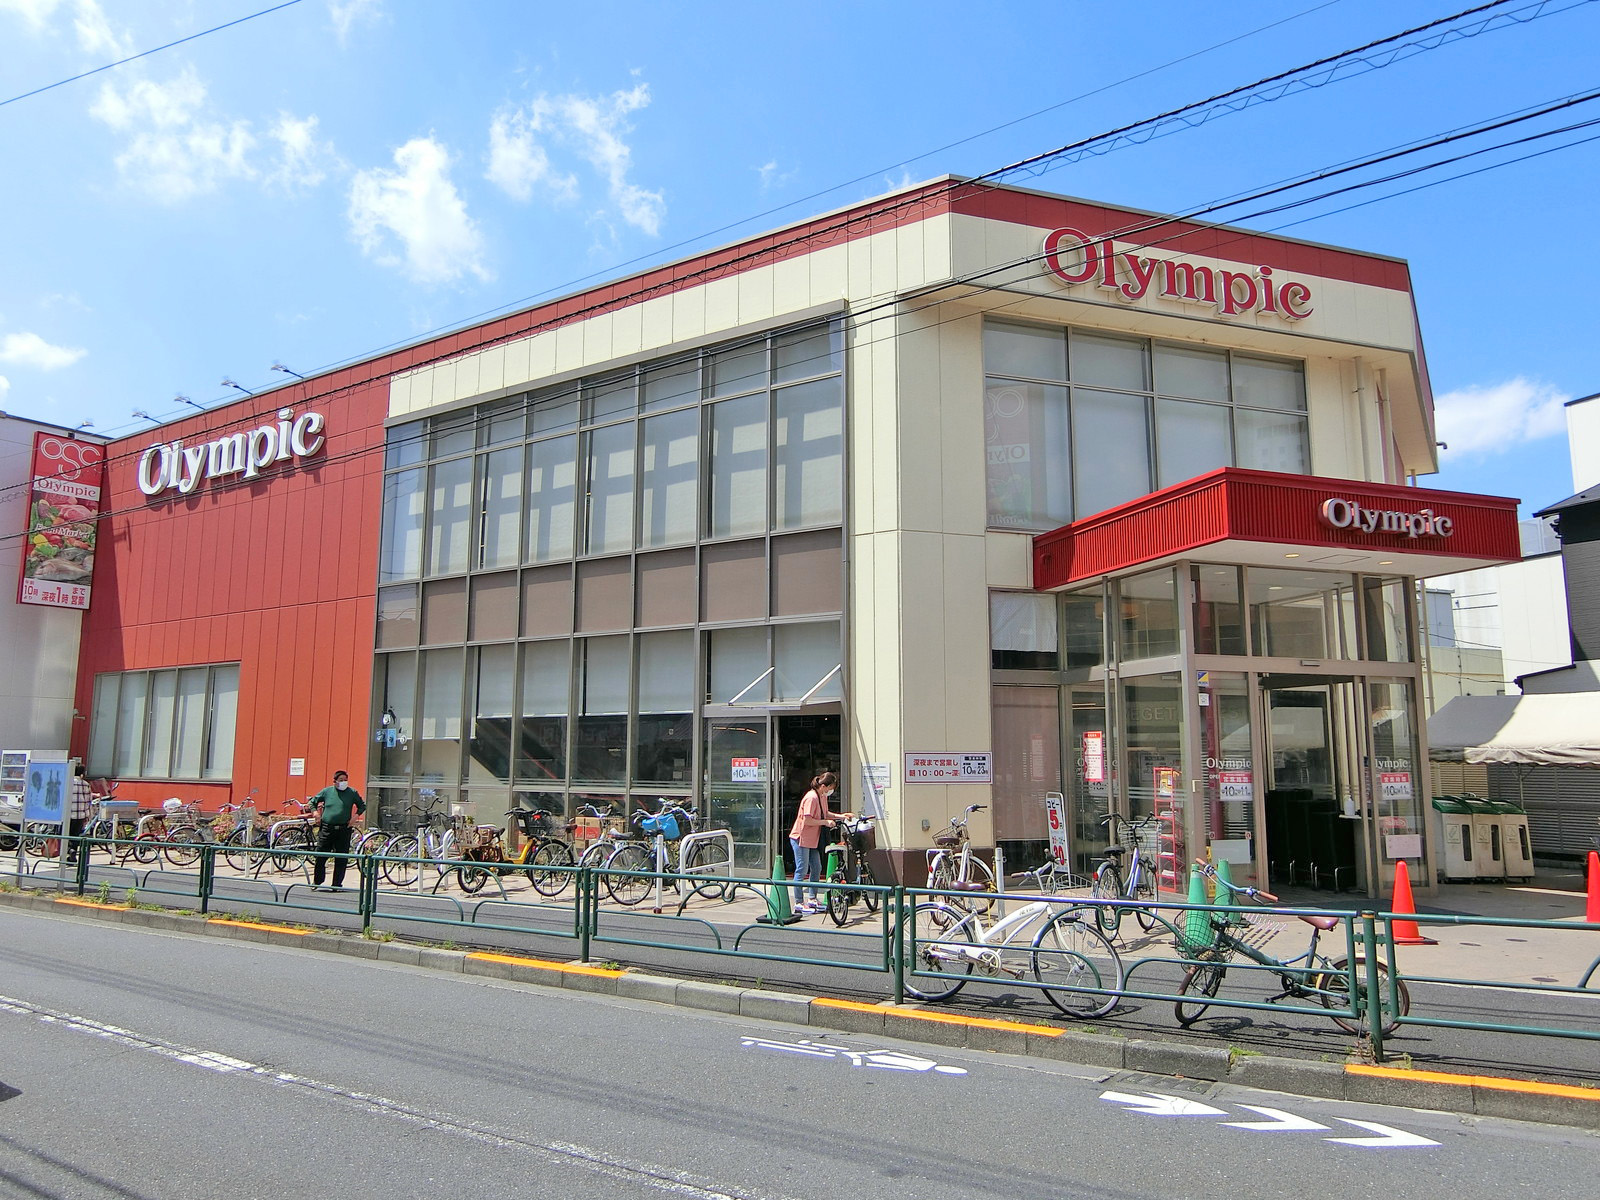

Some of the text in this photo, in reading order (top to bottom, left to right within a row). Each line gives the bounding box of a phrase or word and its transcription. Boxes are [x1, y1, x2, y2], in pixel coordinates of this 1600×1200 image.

[1043, 227, 1314, 320] Olympic
[41, 438, 101, 480] OSC
[138, 408, 325, 496] Olympic
[37, 479, 97, 498] Olympic
[1326, 498, 1454, 539] Olympic
[41, 586, 69, 605] 深夜1時
[71, 595, 86, 606] 営業
[72, 586, 87, 596] まで
[1206, 757, 1253, 770] Olympic
[1375, 758, 1408, 769] lympic
